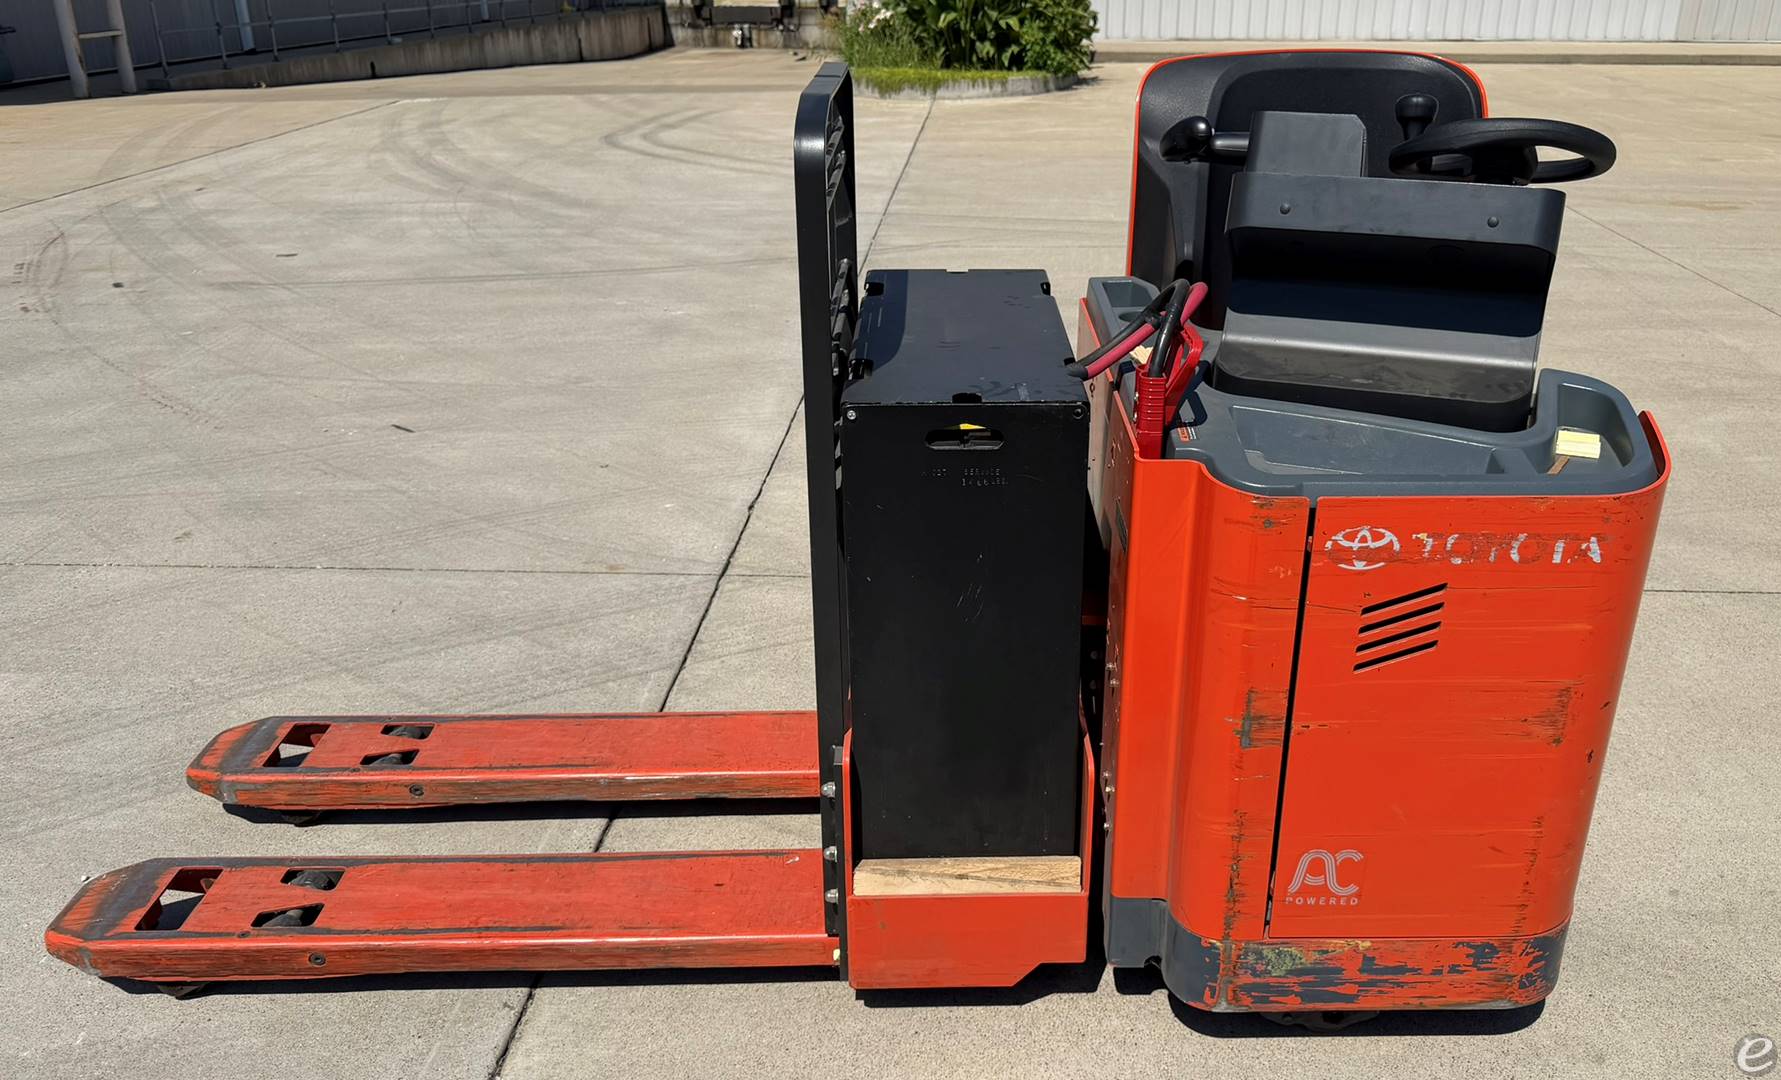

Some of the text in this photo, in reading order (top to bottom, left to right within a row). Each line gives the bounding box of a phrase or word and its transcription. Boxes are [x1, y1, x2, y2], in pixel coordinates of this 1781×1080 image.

[1411, 532, 1606, 564] TOYOTA
[1287, 849, 1364, 896] AC
[1285, 896, 1359, 906] POWERED
